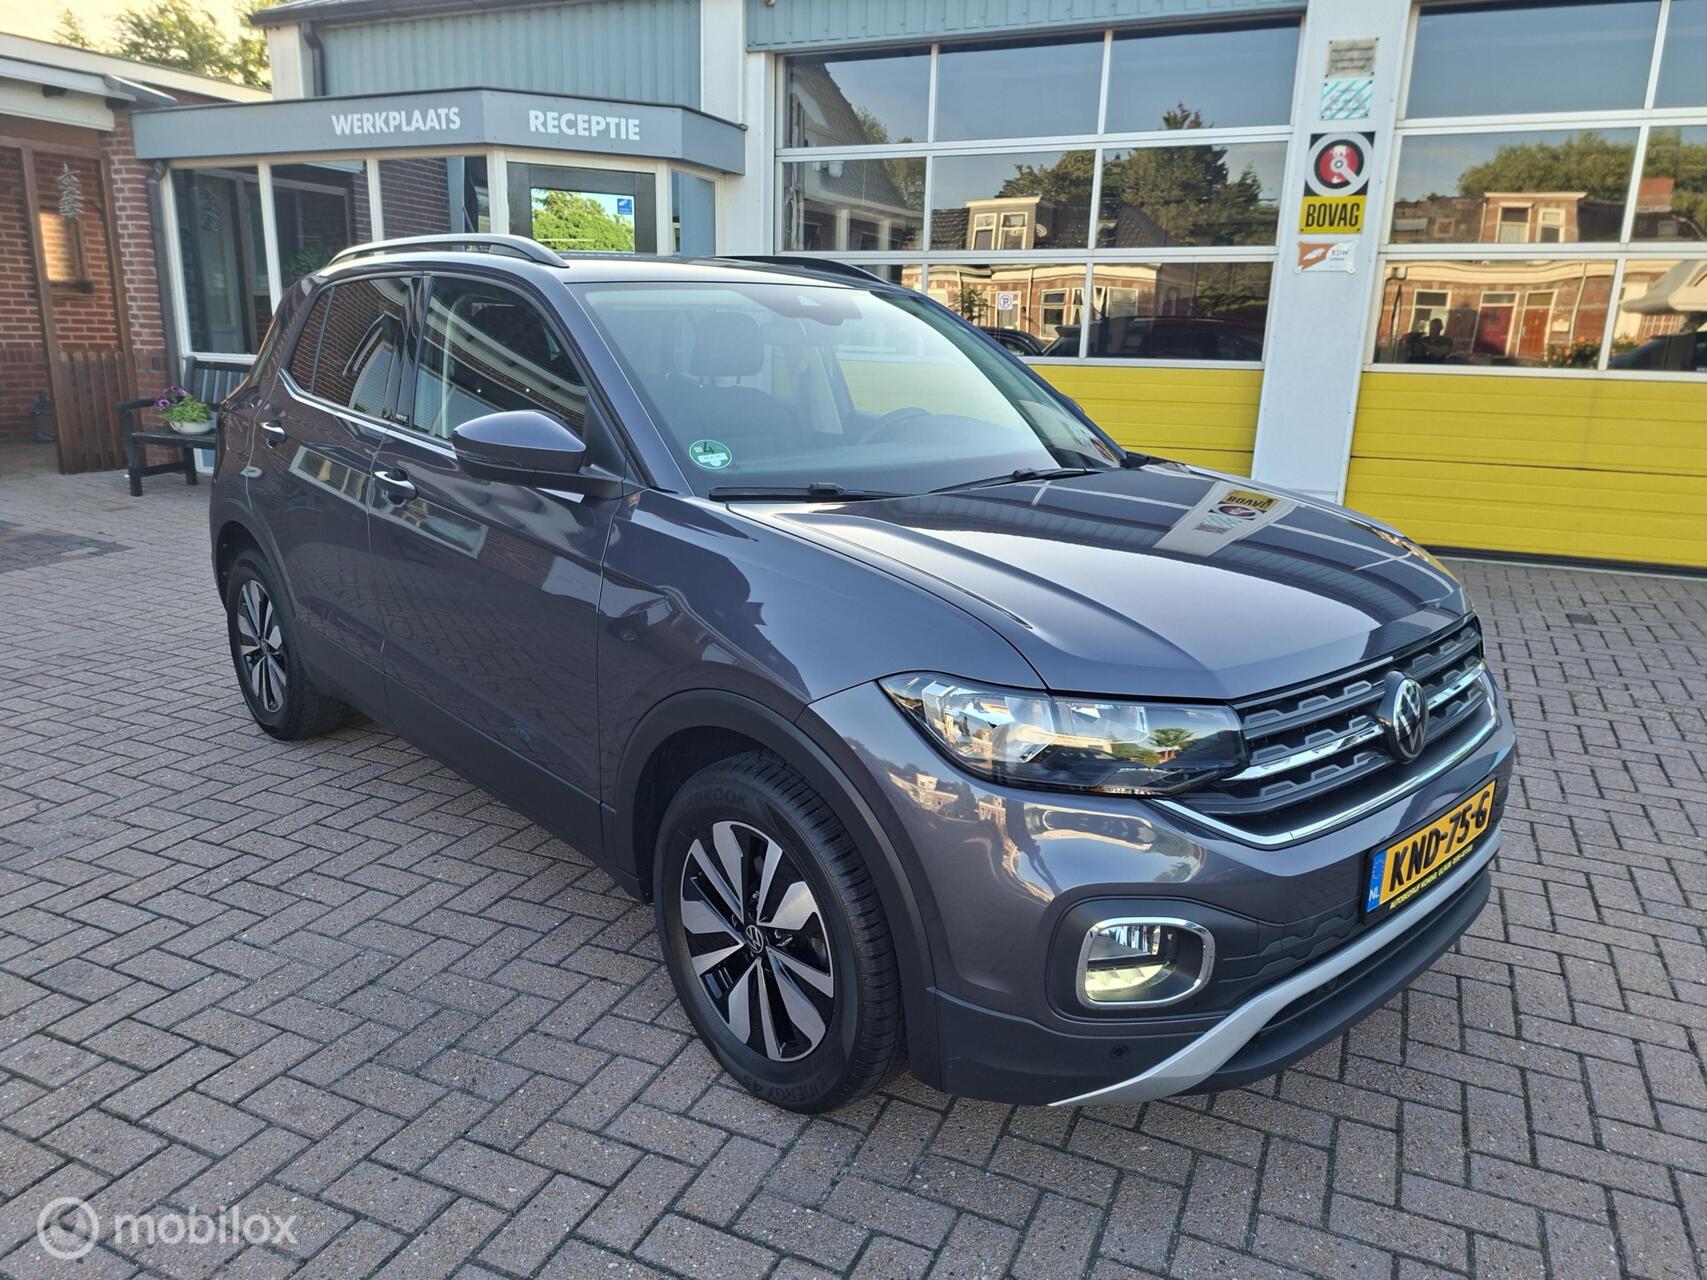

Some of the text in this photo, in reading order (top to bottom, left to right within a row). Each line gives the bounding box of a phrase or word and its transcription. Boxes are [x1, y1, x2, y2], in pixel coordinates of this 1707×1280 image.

[331, 107, 461, 136] WERKPLAATS
[528, 110, 641, 141] RECEPTIE
[1305, 202, 1360, 228] BOVAG
[1368, 887, 1380, 902] NL
